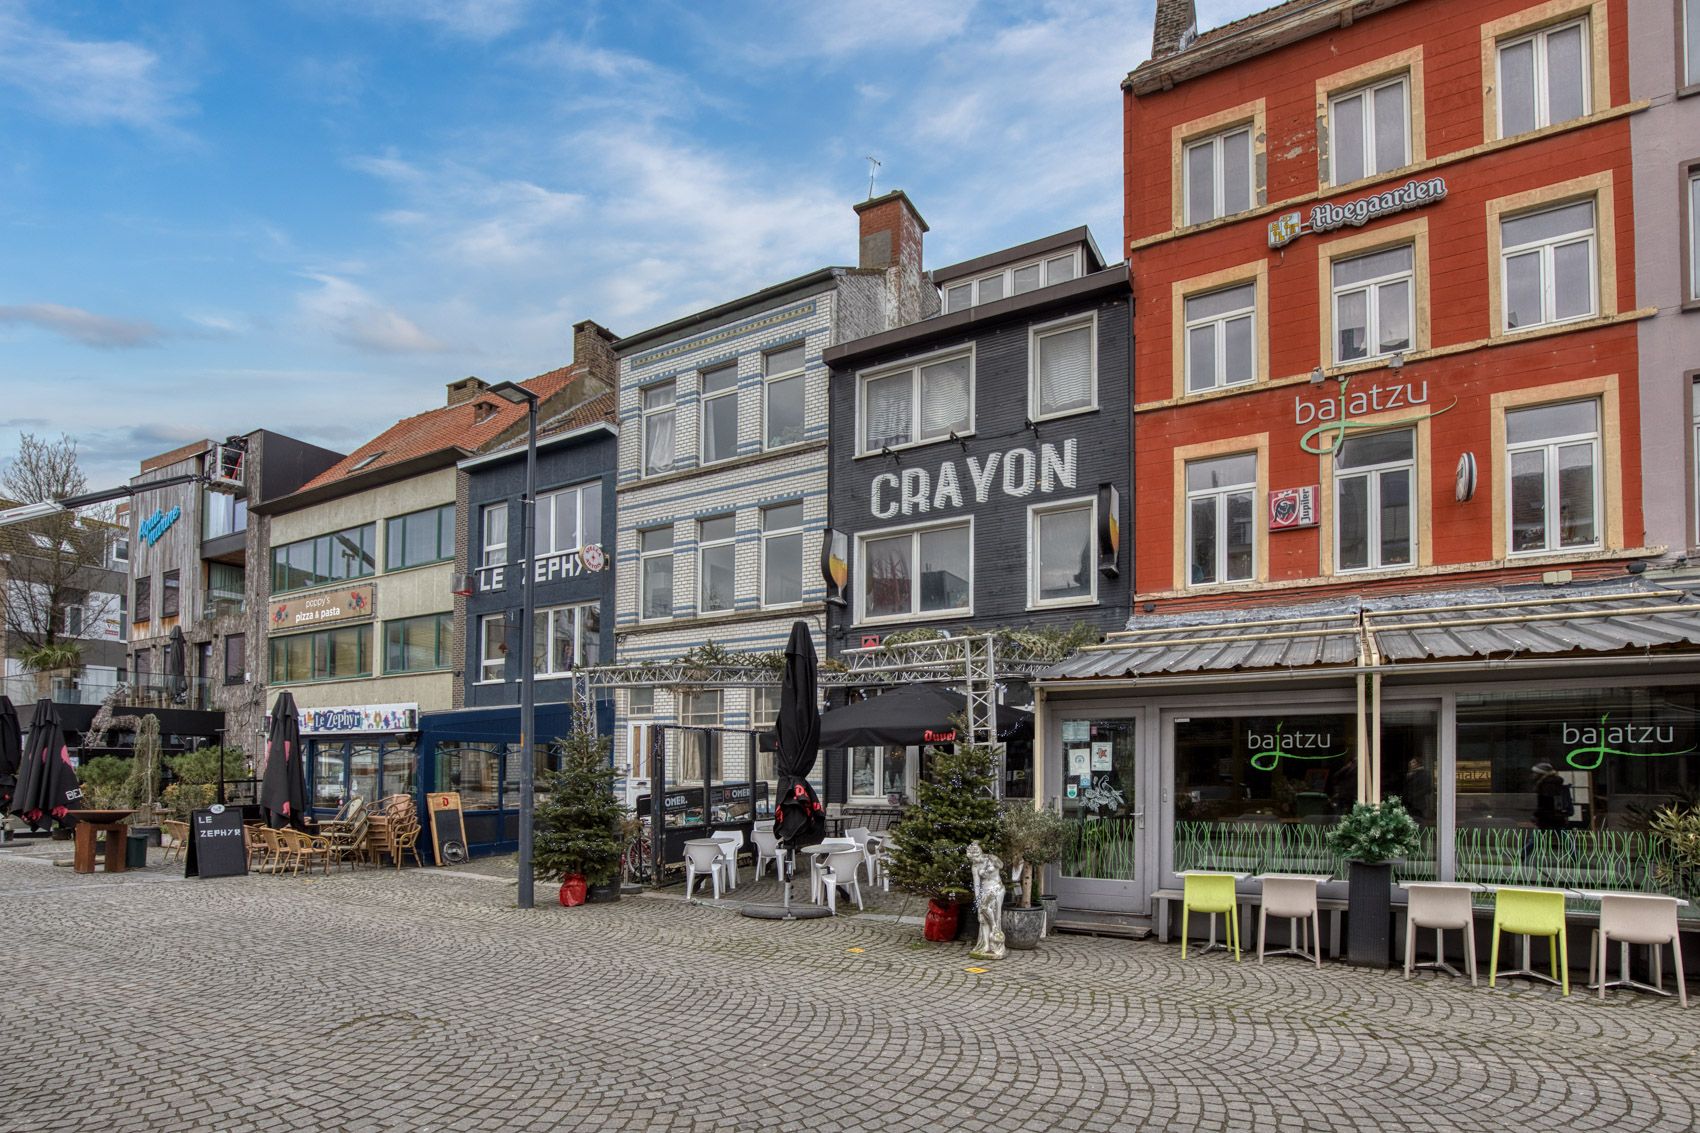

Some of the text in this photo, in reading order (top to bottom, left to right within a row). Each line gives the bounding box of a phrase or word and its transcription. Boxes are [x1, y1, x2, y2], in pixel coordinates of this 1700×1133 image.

[1311, 178, 1447, 229] Hoegaarden
[1295, 377, 1430, 454] bajatzu
[871, 438, 1077, 519] CRAYON
[1301, 488, 1311, 522] Jupiler
[480, 567, 504, 592] LE
[305, 595, 331, 609] poppy's
[295, 612, 314, 624] pizza
[320, 607, 341, 620] pasta
[315, 709, 359, 729] Le Zephyr
[923, 730, 957, 742] Duvel
[1248, 721, 1332, 770] bajatzu
[1562, 712, 1674, 769] bajatzu
[665, 796, 688, 808] OMER.
[198, 816, 213, 824] LE
[200, 829, 241, 838] ZEPHYR
